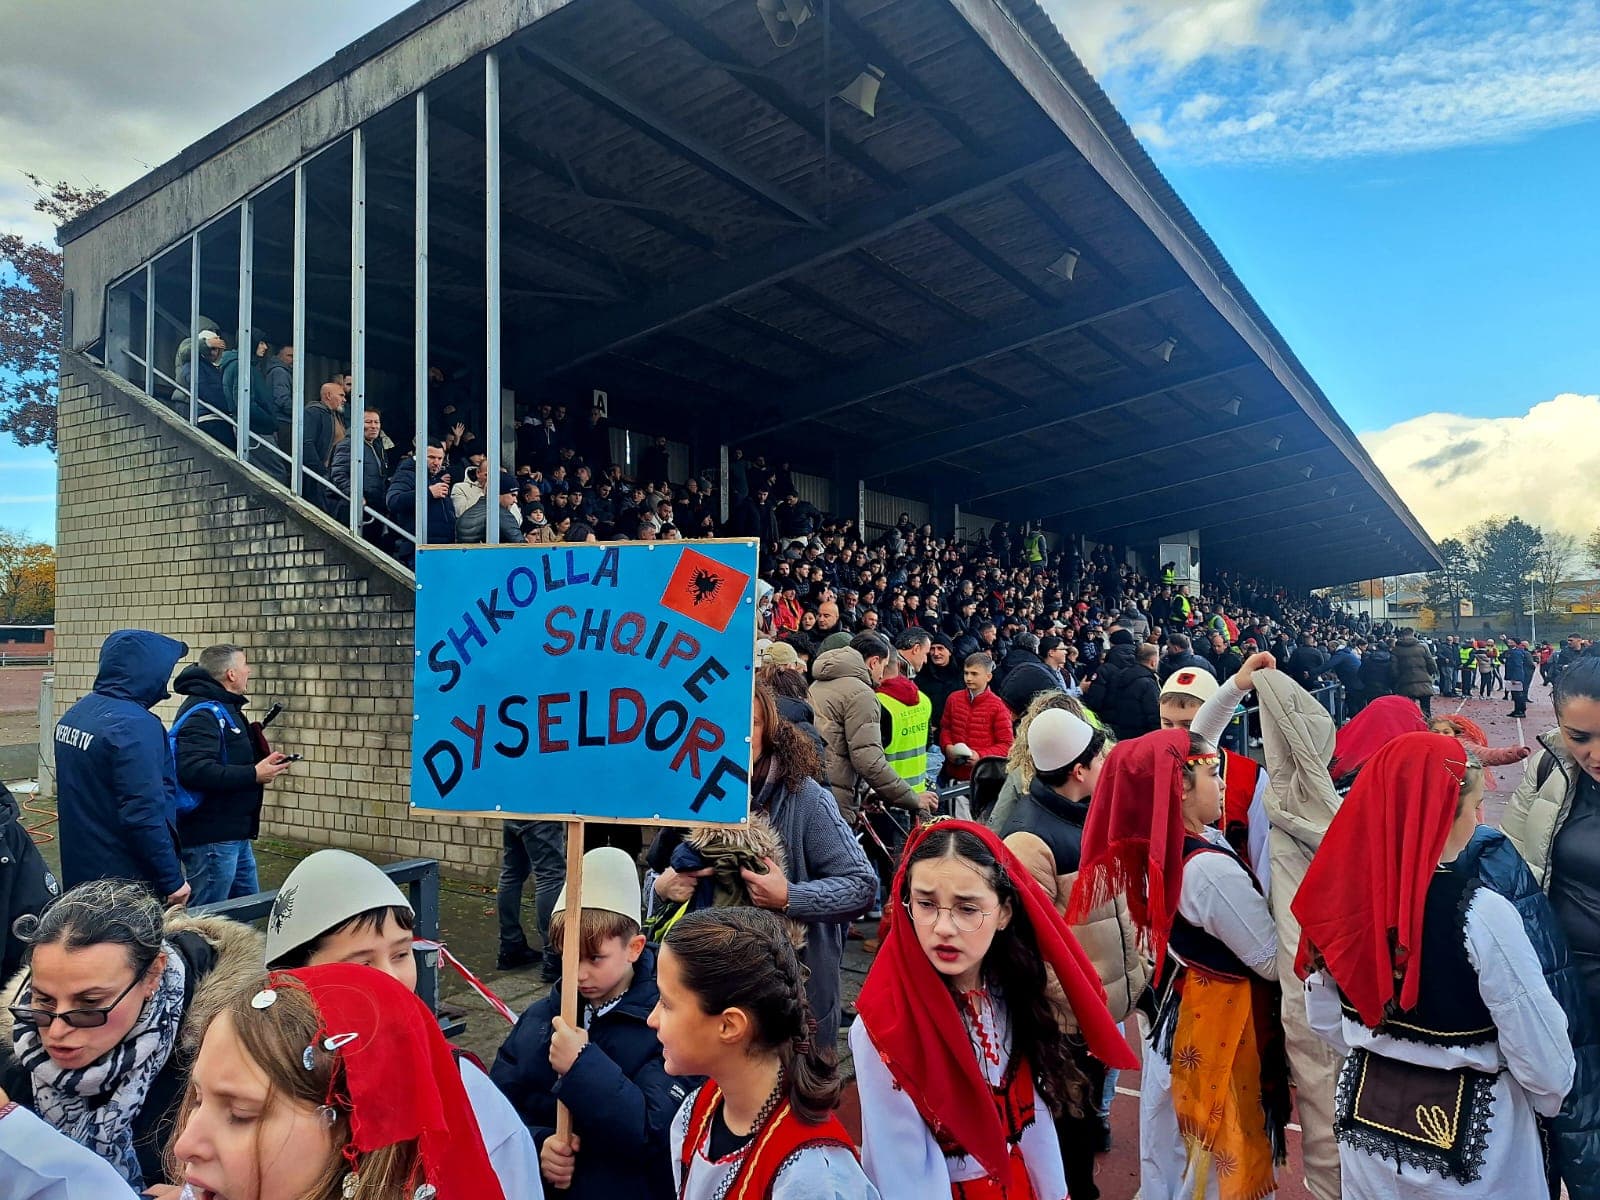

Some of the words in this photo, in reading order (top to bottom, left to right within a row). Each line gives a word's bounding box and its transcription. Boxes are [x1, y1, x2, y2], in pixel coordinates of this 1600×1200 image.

[597, 394, 606, 415] A
[428, 548, 620, 693] SHKOLLA
[543, 605, 730, 703] SHQIPE
[79, 732, 94, 751] TV
[423, 688, 749, 813] DYSELDORF
